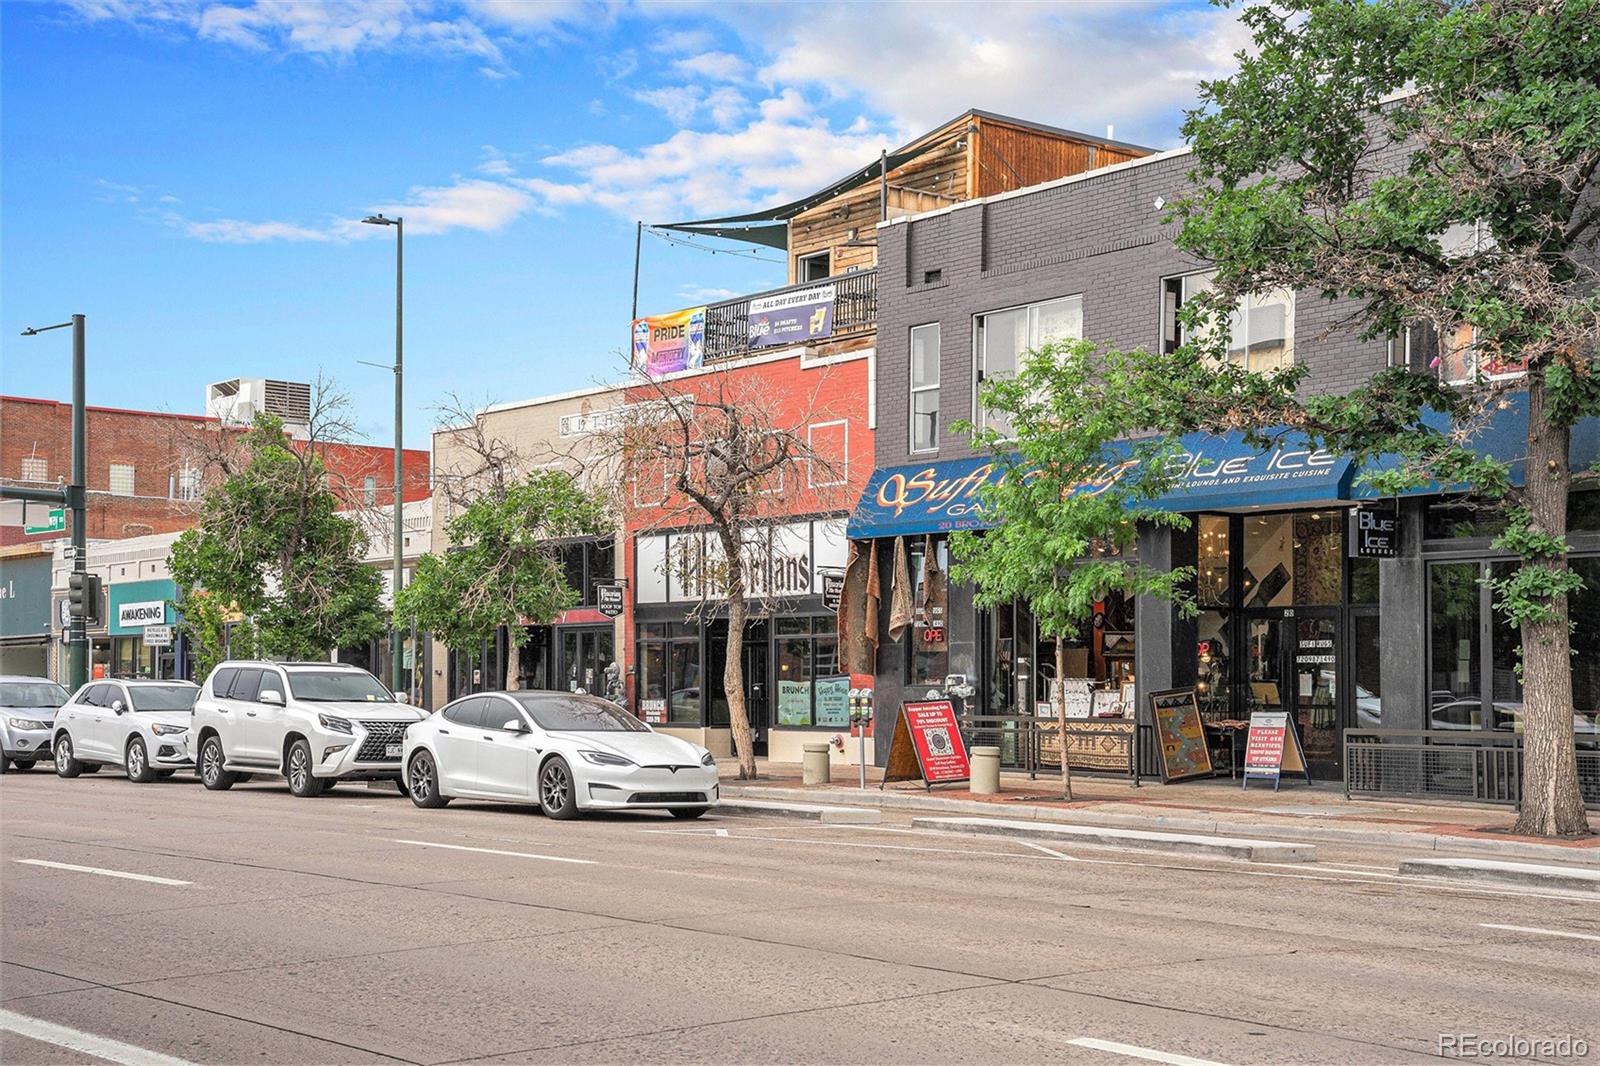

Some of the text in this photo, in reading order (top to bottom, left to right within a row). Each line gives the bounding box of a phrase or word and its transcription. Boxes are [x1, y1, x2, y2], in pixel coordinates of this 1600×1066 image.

[762, 300, 773, 309] ALL
[775, 298, 786, 307] DAY
[787, 294, 807, 305] EVERY
[808, 292, 821, 301] DAY
[653, 324, 685, 342] PRIDE
[749, 322, 770, 338] Blue
[1186, 479, 1219, 488] LOUNGE
[1242, 472, 1289, 483] EXQUISITE
[1293, 468, 1331, 478] CUISINE
[121, 606, 161, 621] AWAKENING
[782, 685, 809, 695] BRUNCH
